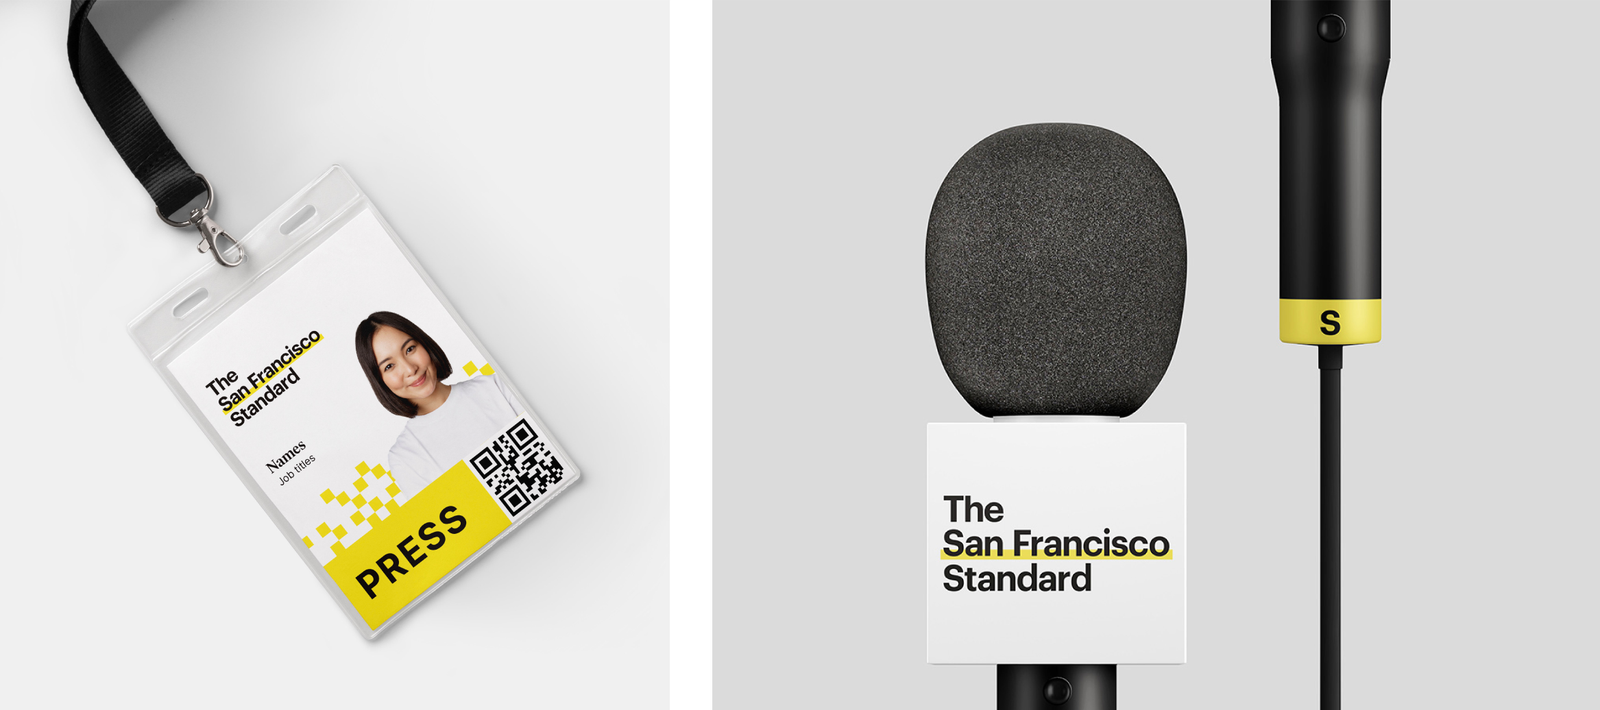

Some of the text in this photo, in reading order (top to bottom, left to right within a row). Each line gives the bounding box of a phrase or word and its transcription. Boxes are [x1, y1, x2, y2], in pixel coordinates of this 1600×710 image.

[1320, 310, 1341, 336] S
[205, 371, 239, 396] The
[218, 330, 321, 412] San Francisco
[230, 367, 301, 427] Standard
[265, 440, 307, 474] Names
[279, 454, 316, 486] Job titles
[943, 495, 1004, 523] The
[355, 505, 467, 600] PRESS
[943, 527, 1170, 557] San Francisco
[943, 563, 1092, 592] Standard
